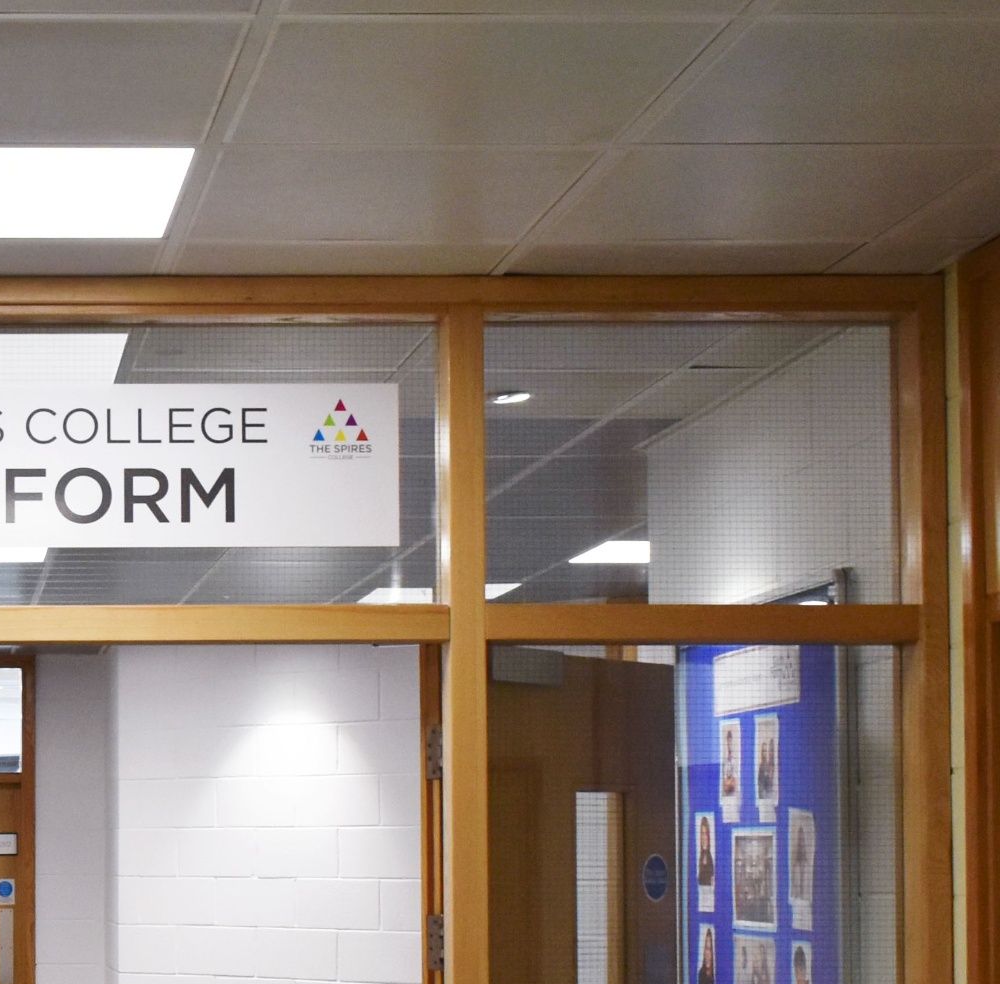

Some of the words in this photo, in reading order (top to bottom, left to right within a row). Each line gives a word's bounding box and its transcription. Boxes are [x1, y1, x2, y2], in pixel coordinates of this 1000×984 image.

[25, 407, 268, 445] COLLEGE
[309, 444, 331, 453] THE
[334, 444, 372, 453] SPIRES
[5, 467, 236, 524] FORM
